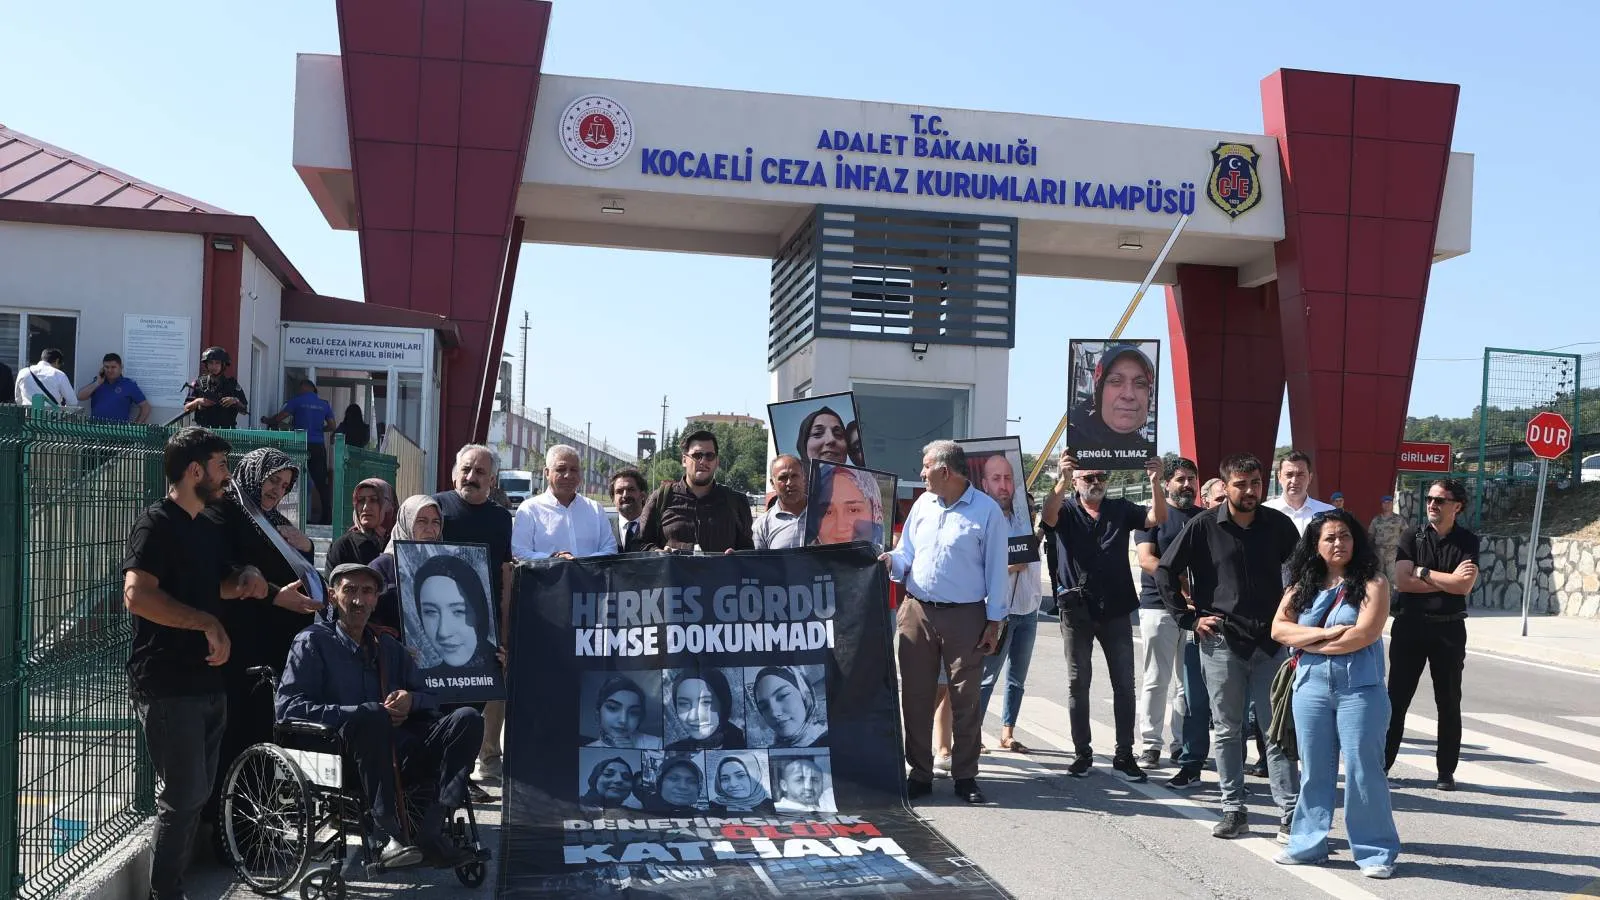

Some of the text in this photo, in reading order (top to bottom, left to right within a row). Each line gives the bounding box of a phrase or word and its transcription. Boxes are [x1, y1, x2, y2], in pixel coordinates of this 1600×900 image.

[910, 114, 949, 136] T.C.
[816, 129, 1037, 166] ADALET BAKANLIĞI
[641, 147, 1196, 217] KOCAELİ CEZA İNFAZ KURUMLARI KAMPÜSÜ
[289, 336, 421, 351] KOCAELİ CEZA İNFAZ KURUMLARI
[349, 349, 376, 358] KABUL
[1529, 424, 1567, 446] DUR
[1076, 448, 1148, 460] ŞENGÜL YILMAZ
[1401, 451, 1445, 464] GİRİLMEZ
[572, 574, 837, 628] HERKES GÖRDÜ
[575, 619, 835, 657] KİMSE DOKUNMADI
[446, 674, 494, 689] TAŞDEMİR
[563, 836, 907, 864] KATLİAM
